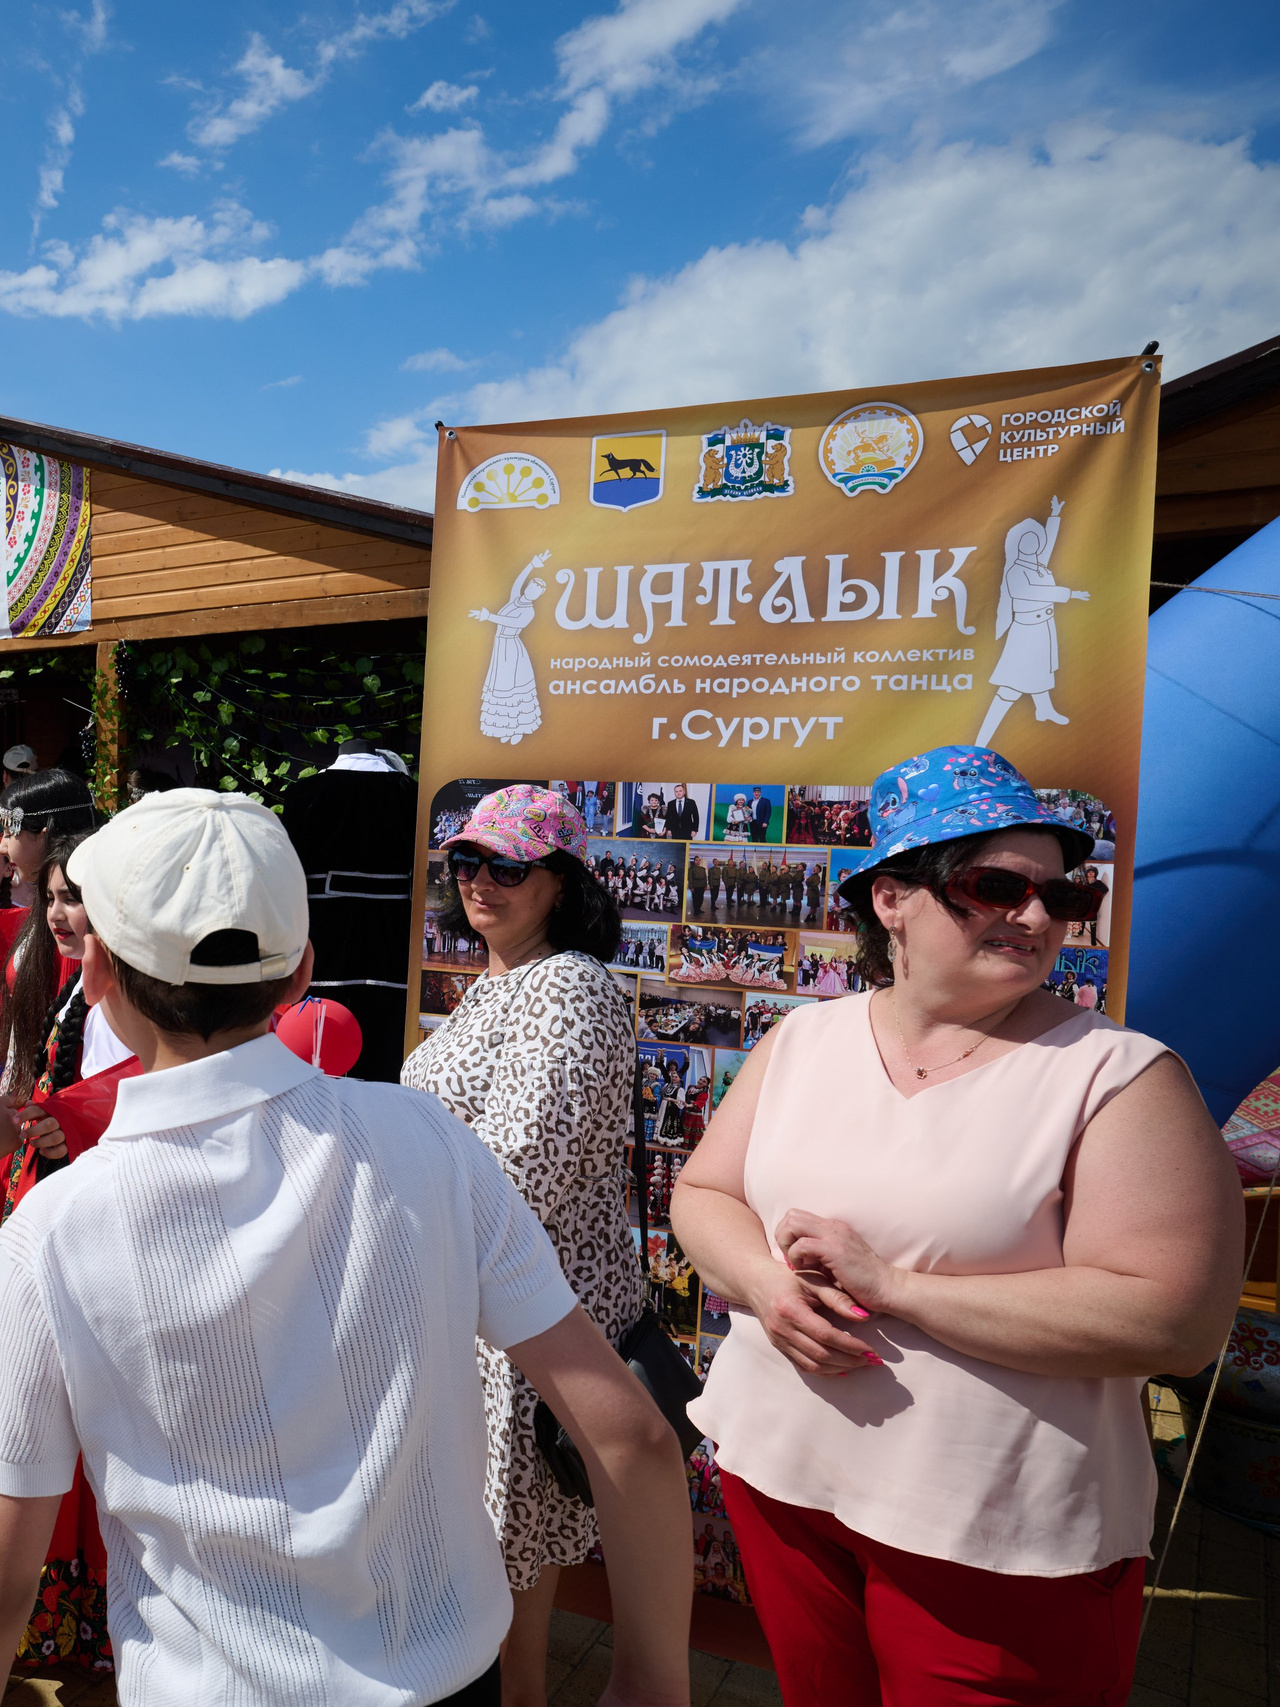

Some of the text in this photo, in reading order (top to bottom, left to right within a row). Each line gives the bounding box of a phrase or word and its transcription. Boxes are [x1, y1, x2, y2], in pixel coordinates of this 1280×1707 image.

[1001, 400, 1121, 427] ГОРОДСКОЙ
[1000, 418, 1125, 444] КУЛЬТУРНЫЙ
[999, 444, 1059, 463] ЦЕНТР
[555, 546, 977, 644] ШАТЛЫК
[550, 647, 975, 672] народный сомодеятельный коллектив
[548, 673, 973, 698] ансамбль народного танца
[651, 709, 843, 748] г.Сургут
